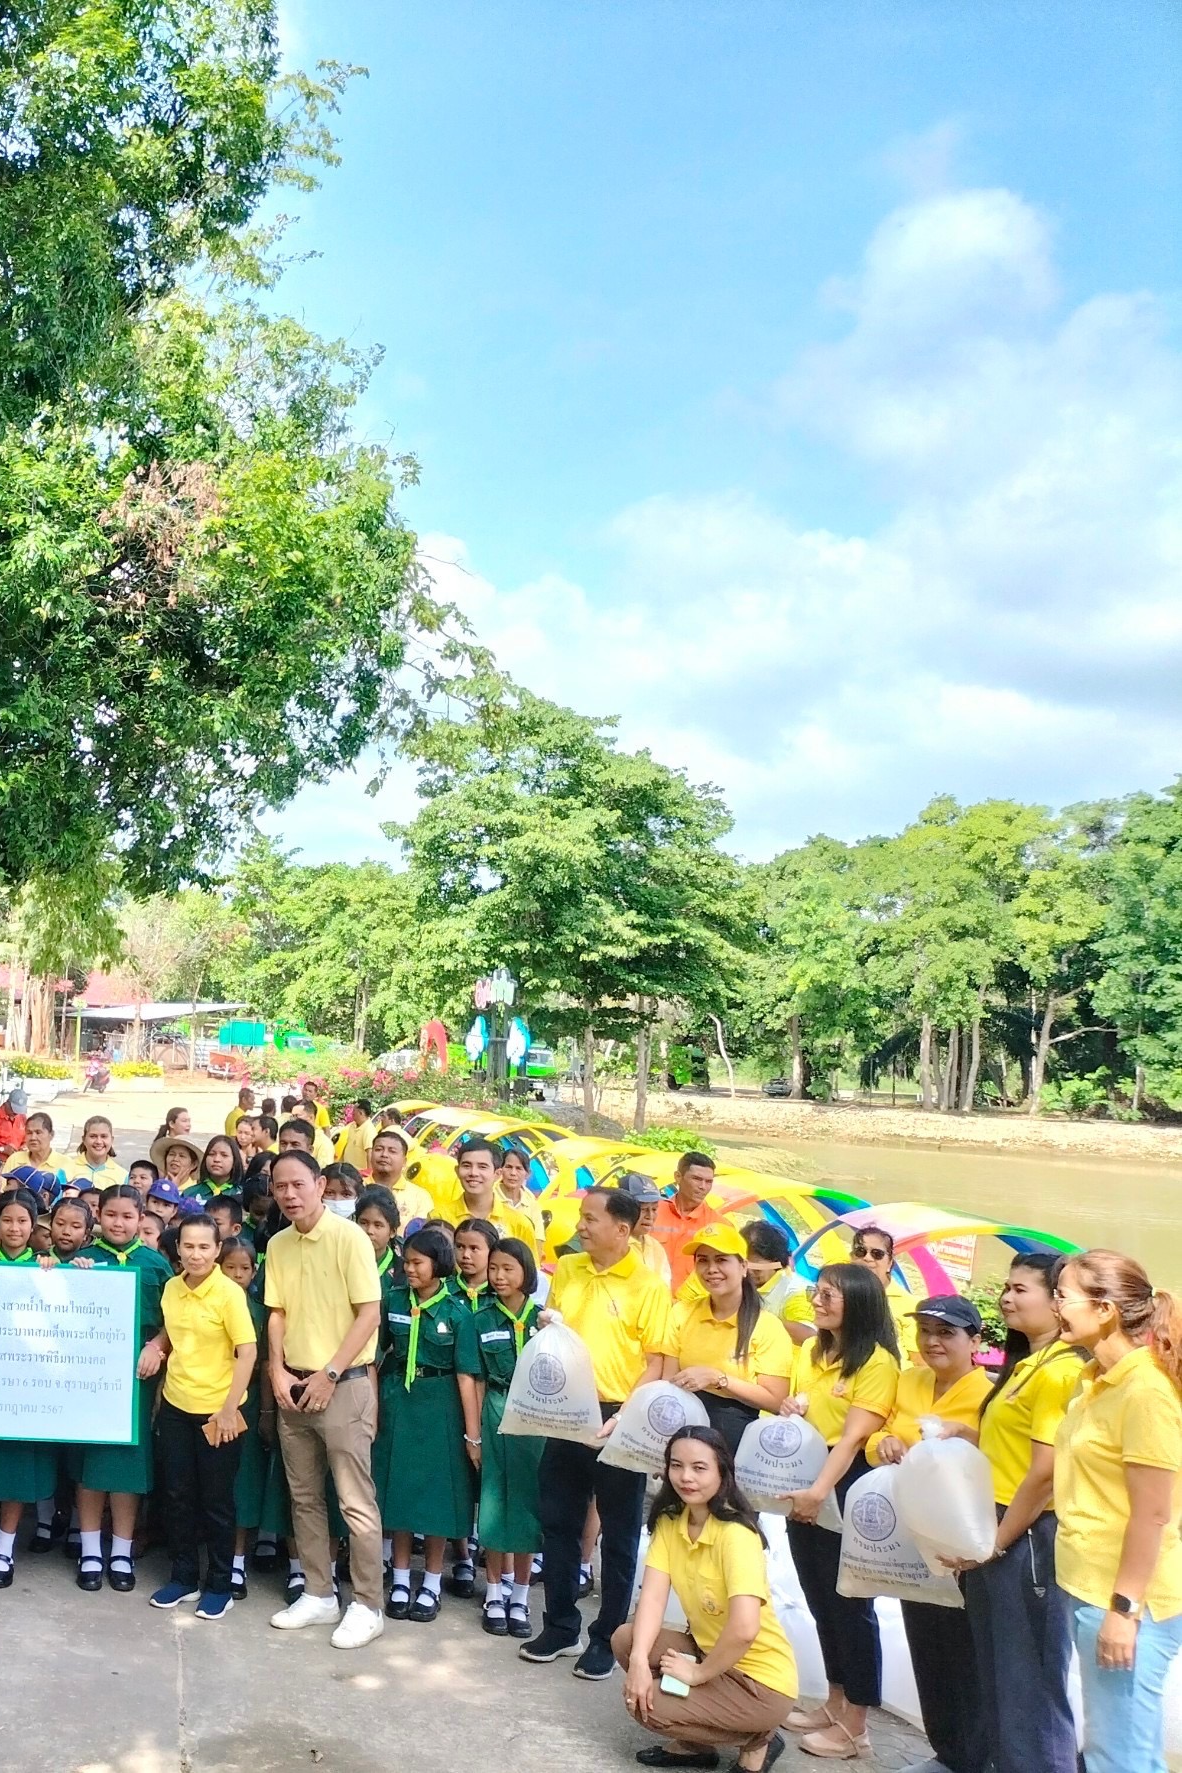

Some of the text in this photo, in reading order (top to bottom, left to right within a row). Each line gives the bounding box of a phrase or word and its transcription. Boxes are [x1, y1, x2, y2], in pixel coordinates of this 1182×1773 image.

[22, 1377, 29, 1388] 6
[31, 1378, 52, 1389] รอบ
[526, 1389, 569, 1405] กรมประมง
[40, 1404, 64, 1415] 2567
[754, 1451, 803, 1469] กรมประมง
[853, 1537, 901, 1553] กรมประมง
